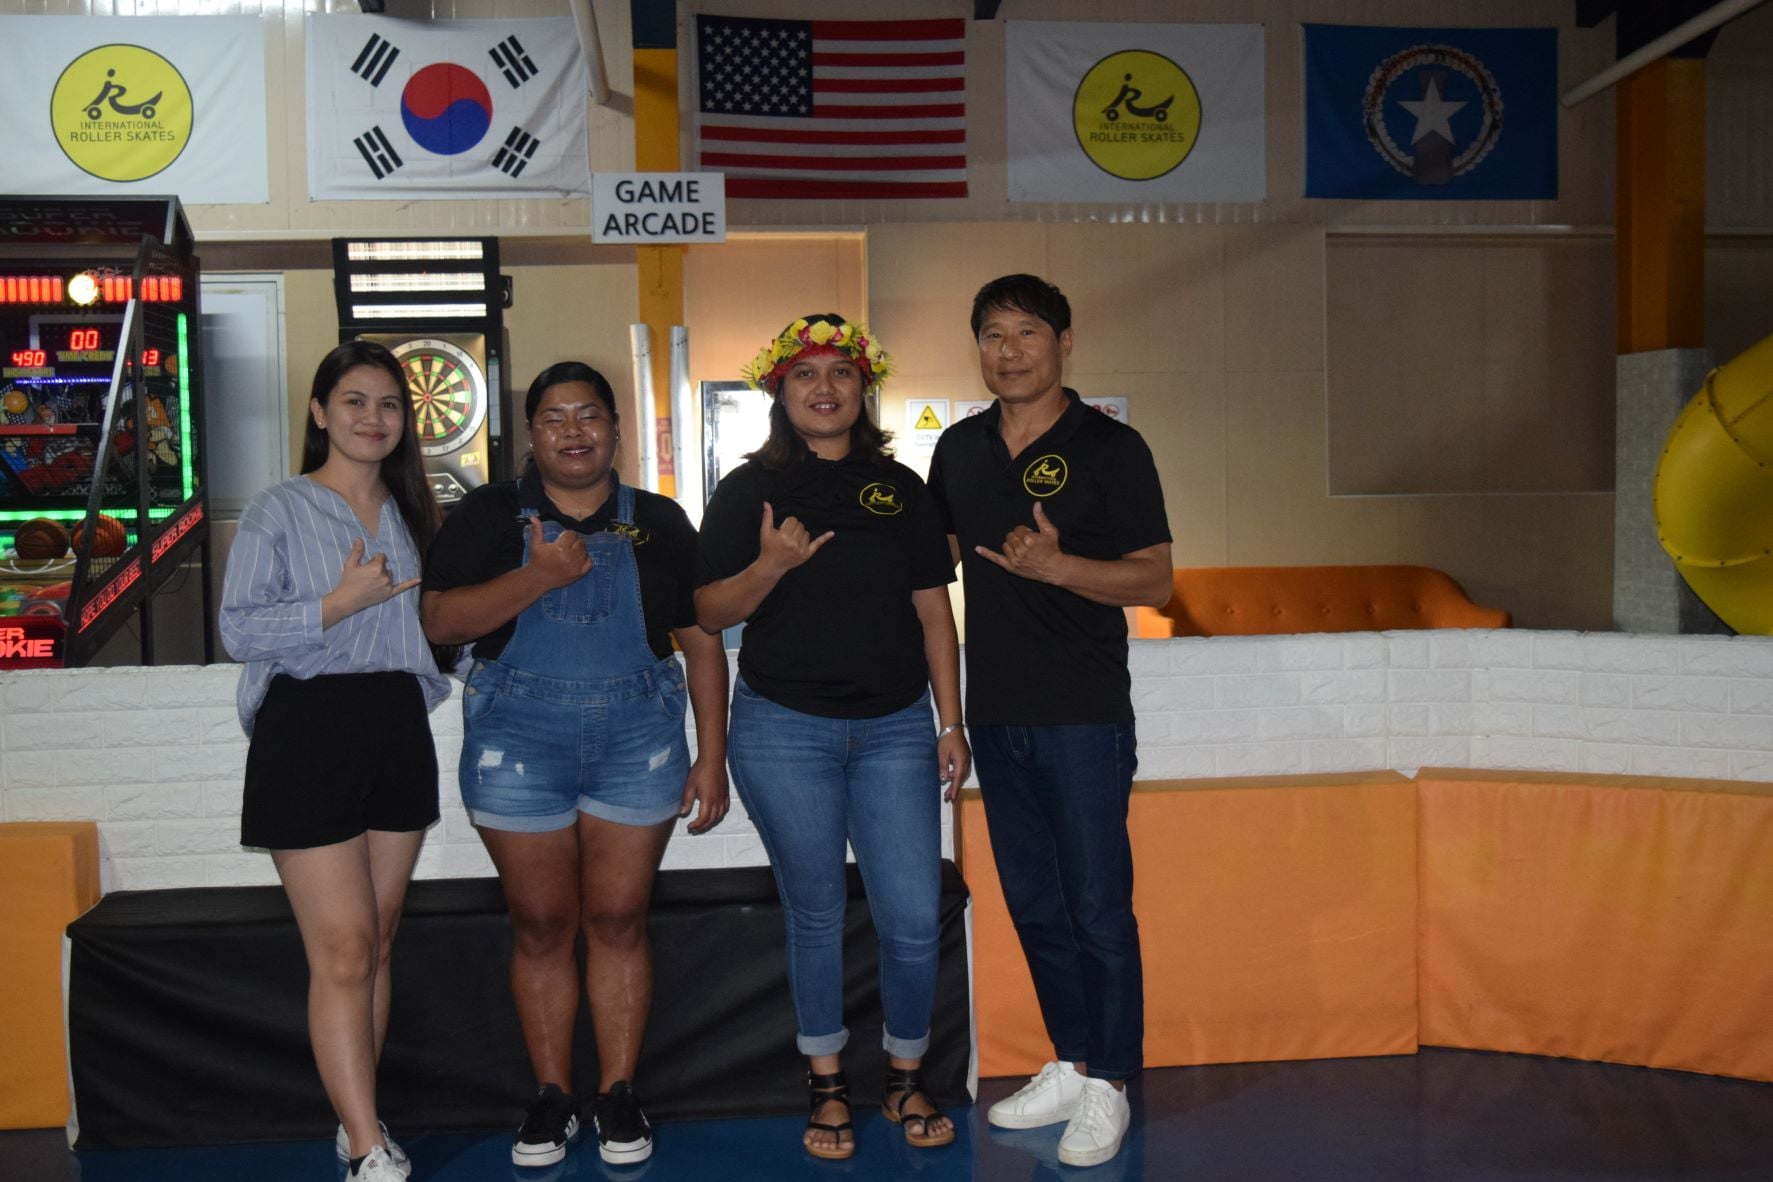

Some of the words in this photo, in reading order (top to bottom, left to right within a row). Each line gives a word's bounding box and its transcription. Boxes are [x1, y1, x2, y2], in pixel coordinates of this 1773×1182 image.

[80, 121, 164, 130] INTERNATIONAL
[1099, 123, 1175, 132] INTERNATIONAL
[70, 131, 122, 142] ROLLER
[126, 131, 175, 141] SKATES
[1090, 132, 1137, 142] ROLLER
[1140, 133, 1185, 142] SKATES
[615, 180, 700, 203] GAME
[602, 212, 716, 236] ARCADE
[70, 331, 98, 350] 00
[12, 351, 46, 366] 490
[152, 526, 177, 560] SUPER
